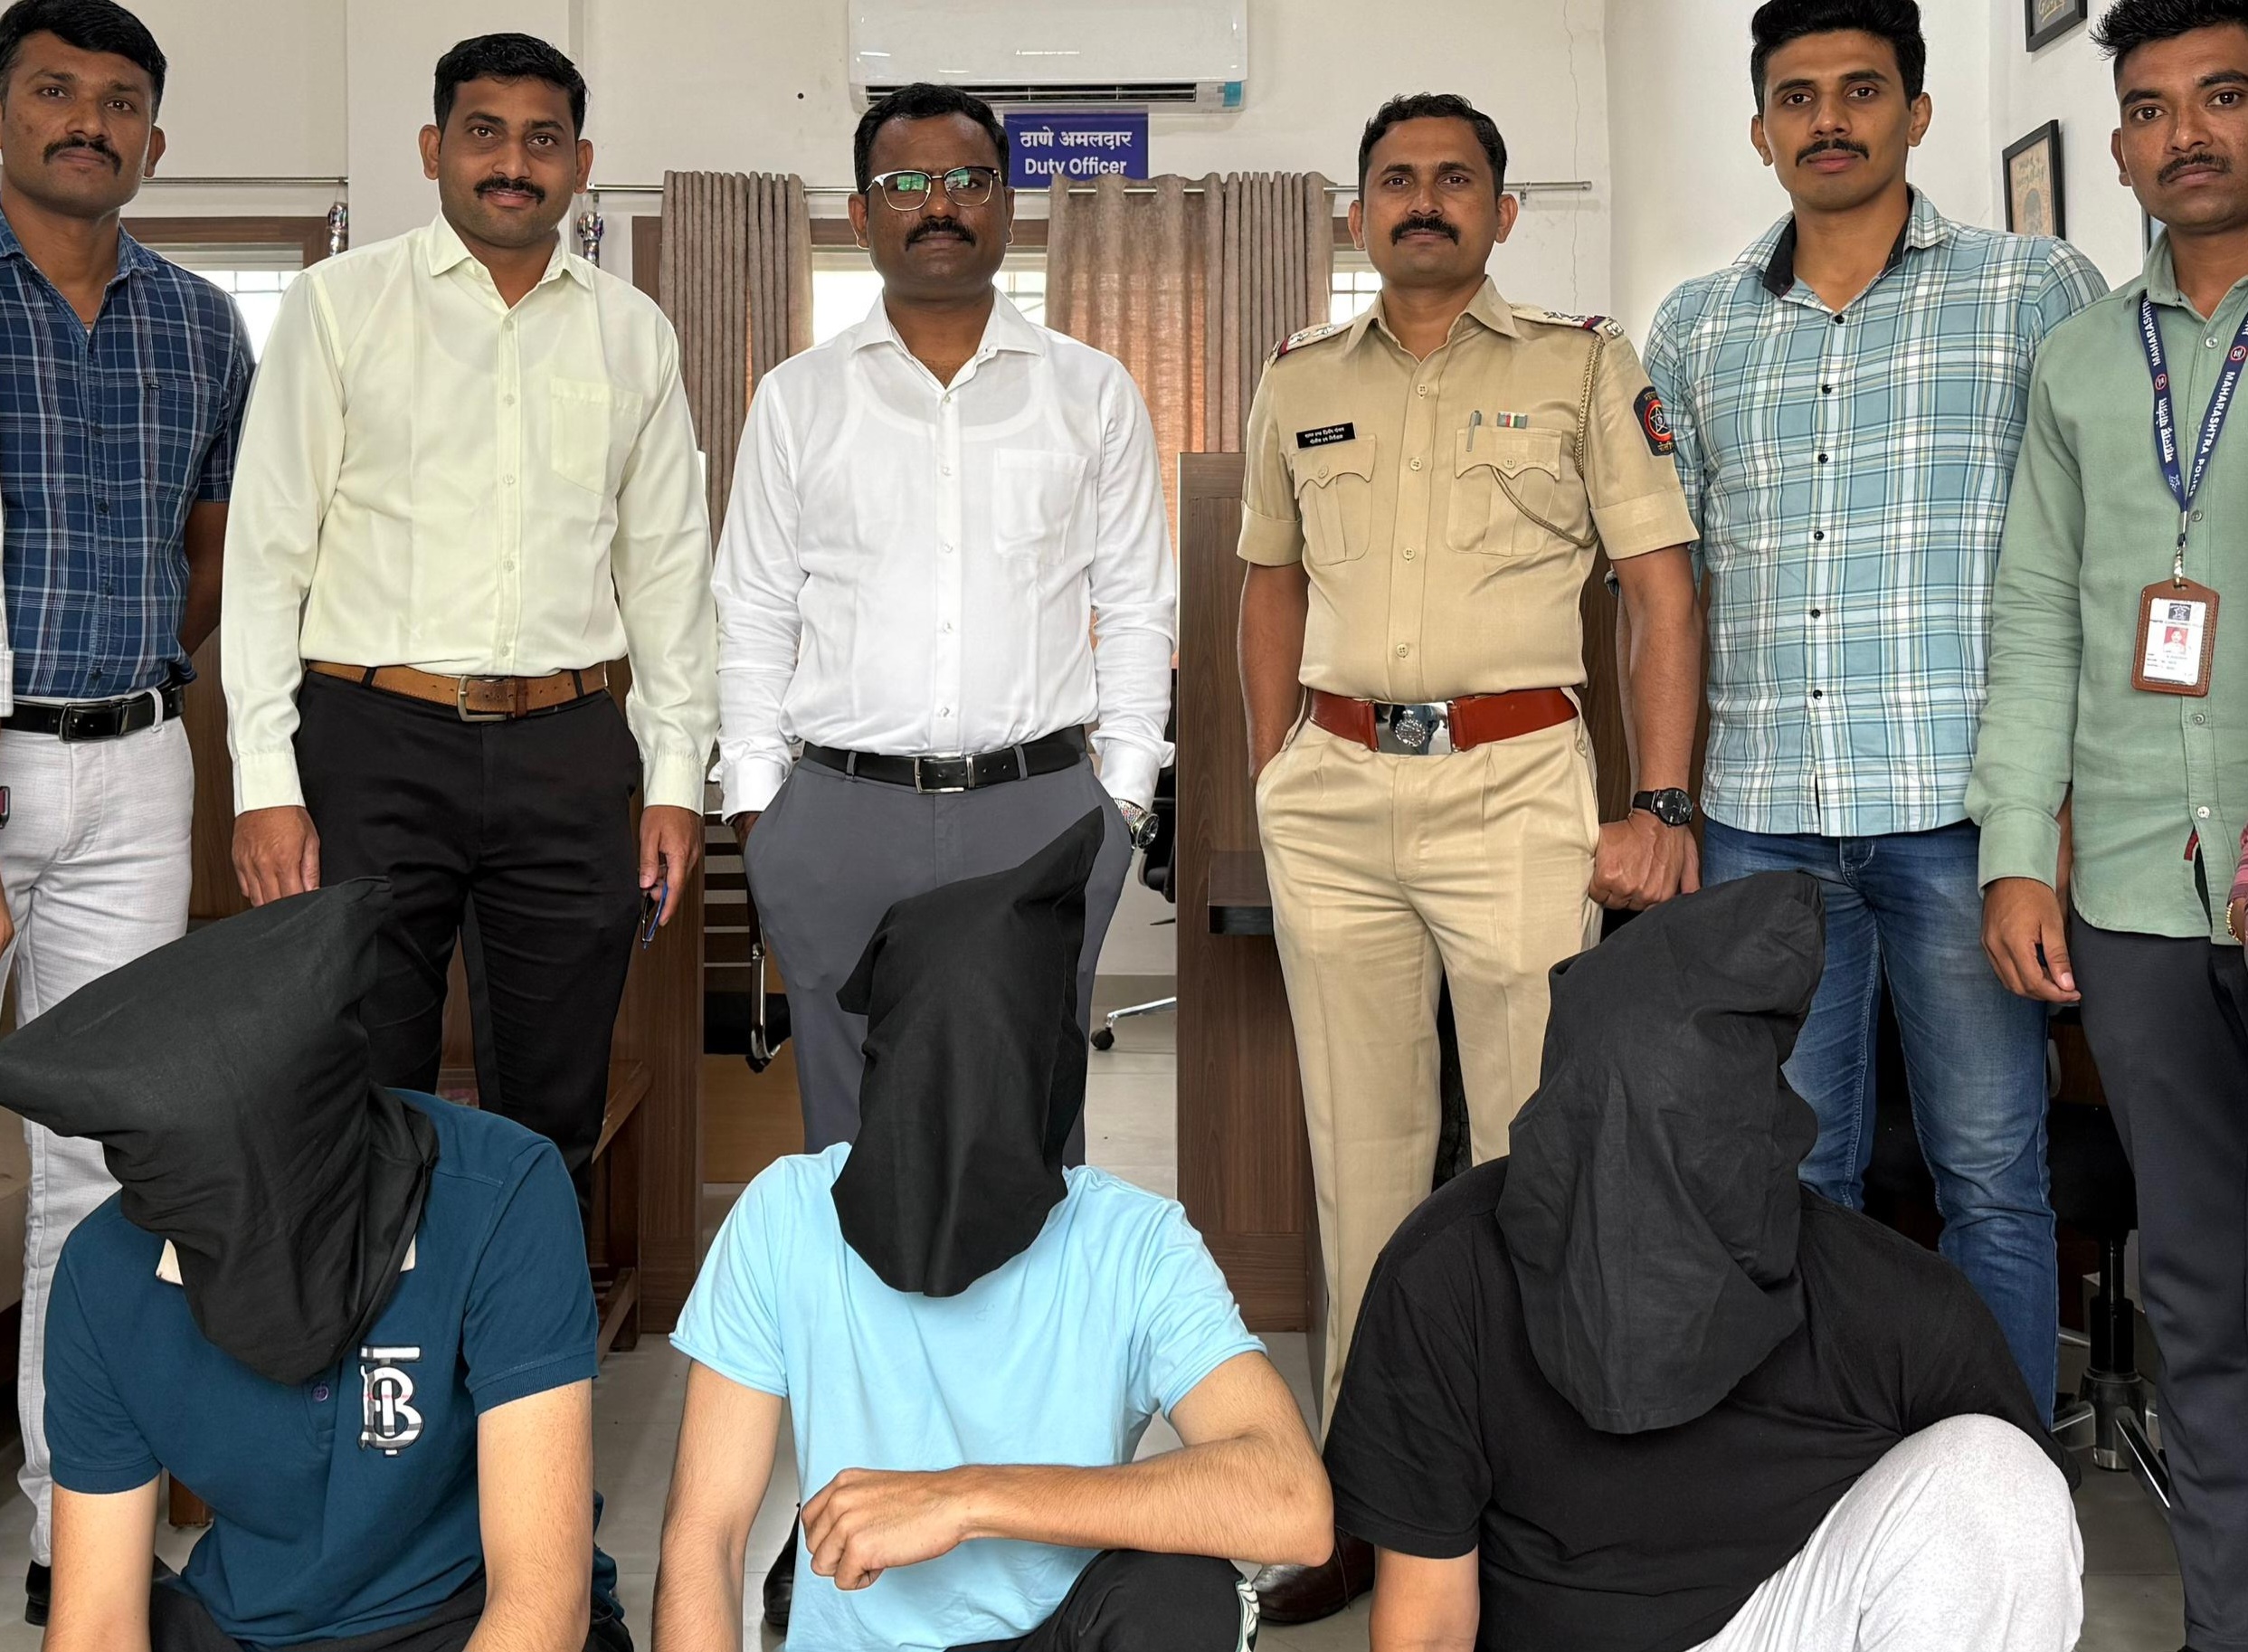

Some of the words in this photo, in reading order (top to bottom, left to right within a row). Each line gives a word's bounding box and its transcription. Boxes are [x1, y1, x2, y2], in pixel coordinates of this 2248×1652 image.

[1020, 126, 1054, 147] ठाणे
[1059, 131, 1133, 150] अमलदार
[1025, 157, 1066, 175] Duty
[1069, 157, 1127, 175] Officer
[2201, 371, 2235, 454] MAHARASHTRA
